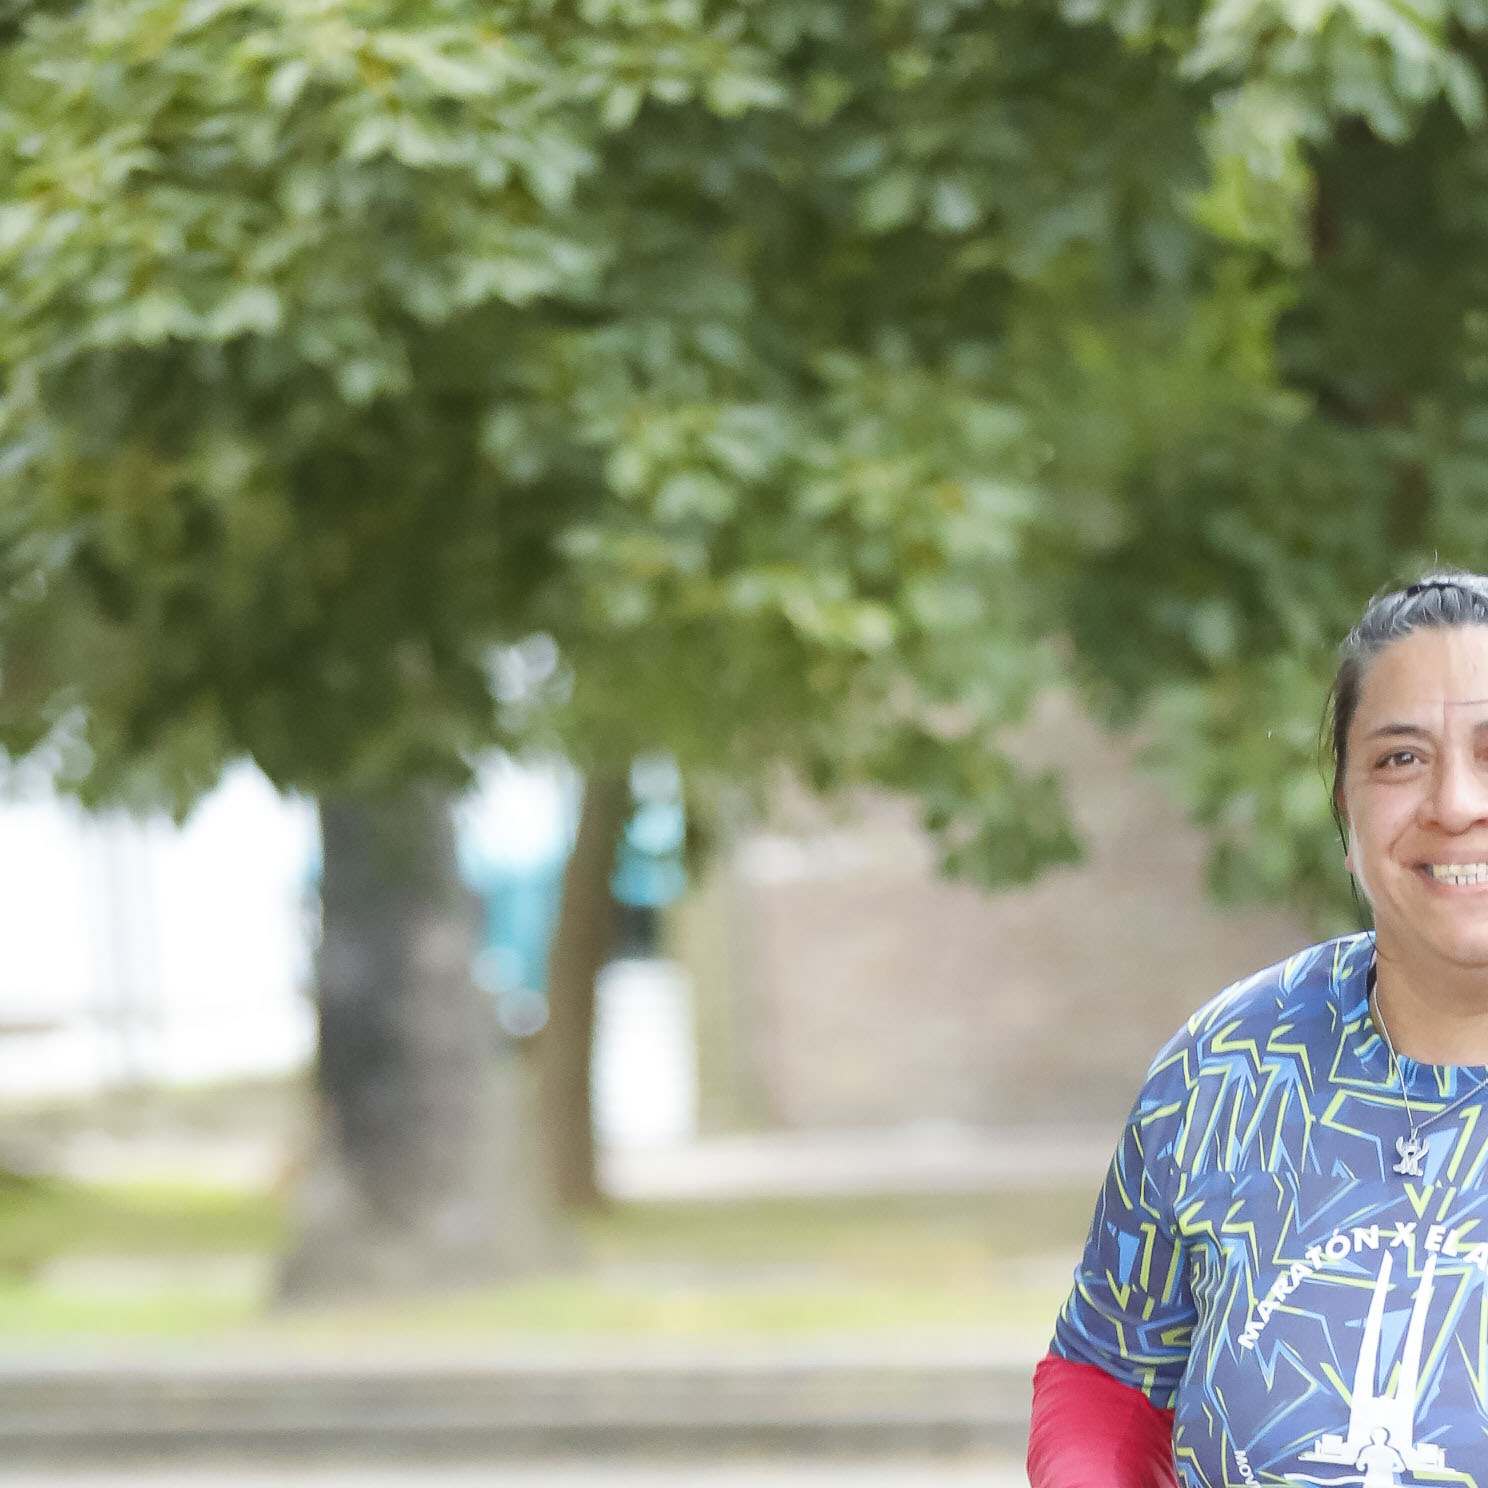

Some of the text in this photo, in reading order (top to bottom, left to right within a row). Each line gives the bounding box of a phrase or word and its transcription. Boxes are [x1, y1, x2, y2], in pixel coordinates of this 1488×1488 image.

[1237, 1224, 1380, 1350] MARATÓN
[1389, 1221, 1417, 1248] X
[1424, 1224, 1459, 1257] EL
